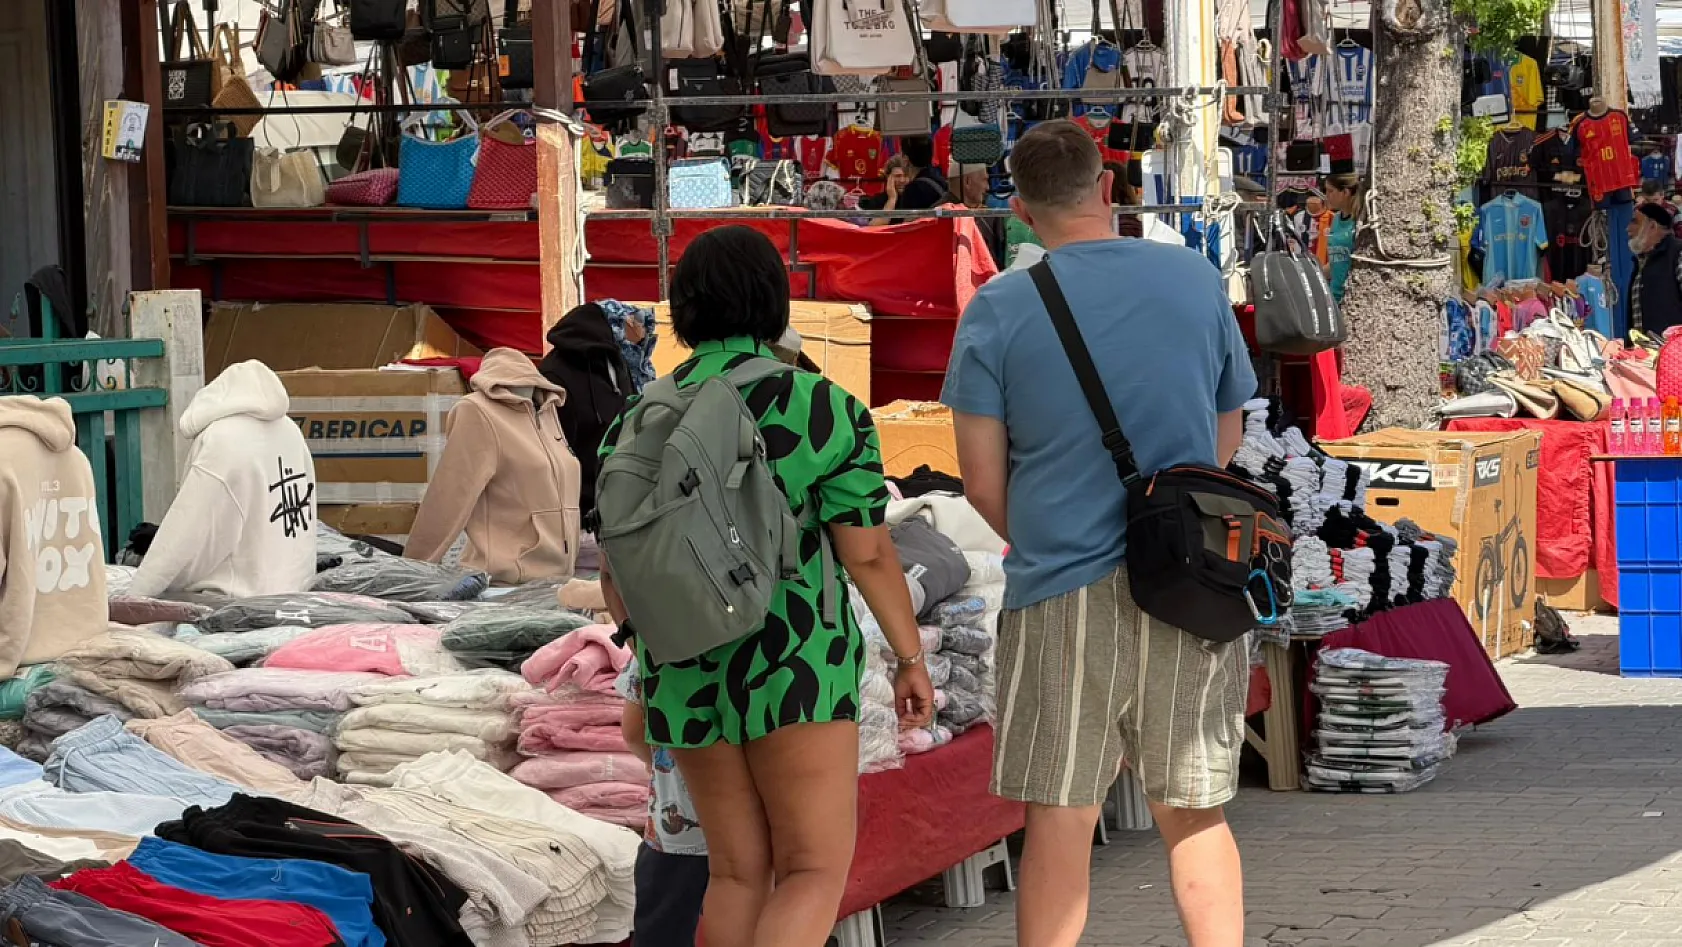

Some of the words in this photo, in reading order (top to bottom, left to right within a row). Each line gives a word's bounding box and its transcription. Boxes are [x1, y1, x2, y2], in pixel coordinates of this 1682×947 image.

[858, 9, 876, 18] THE
[1601, 147, 1614, 161] 10
[308, 419, 428, 438] BERICAP
[35, 542, 95, 594] OX
